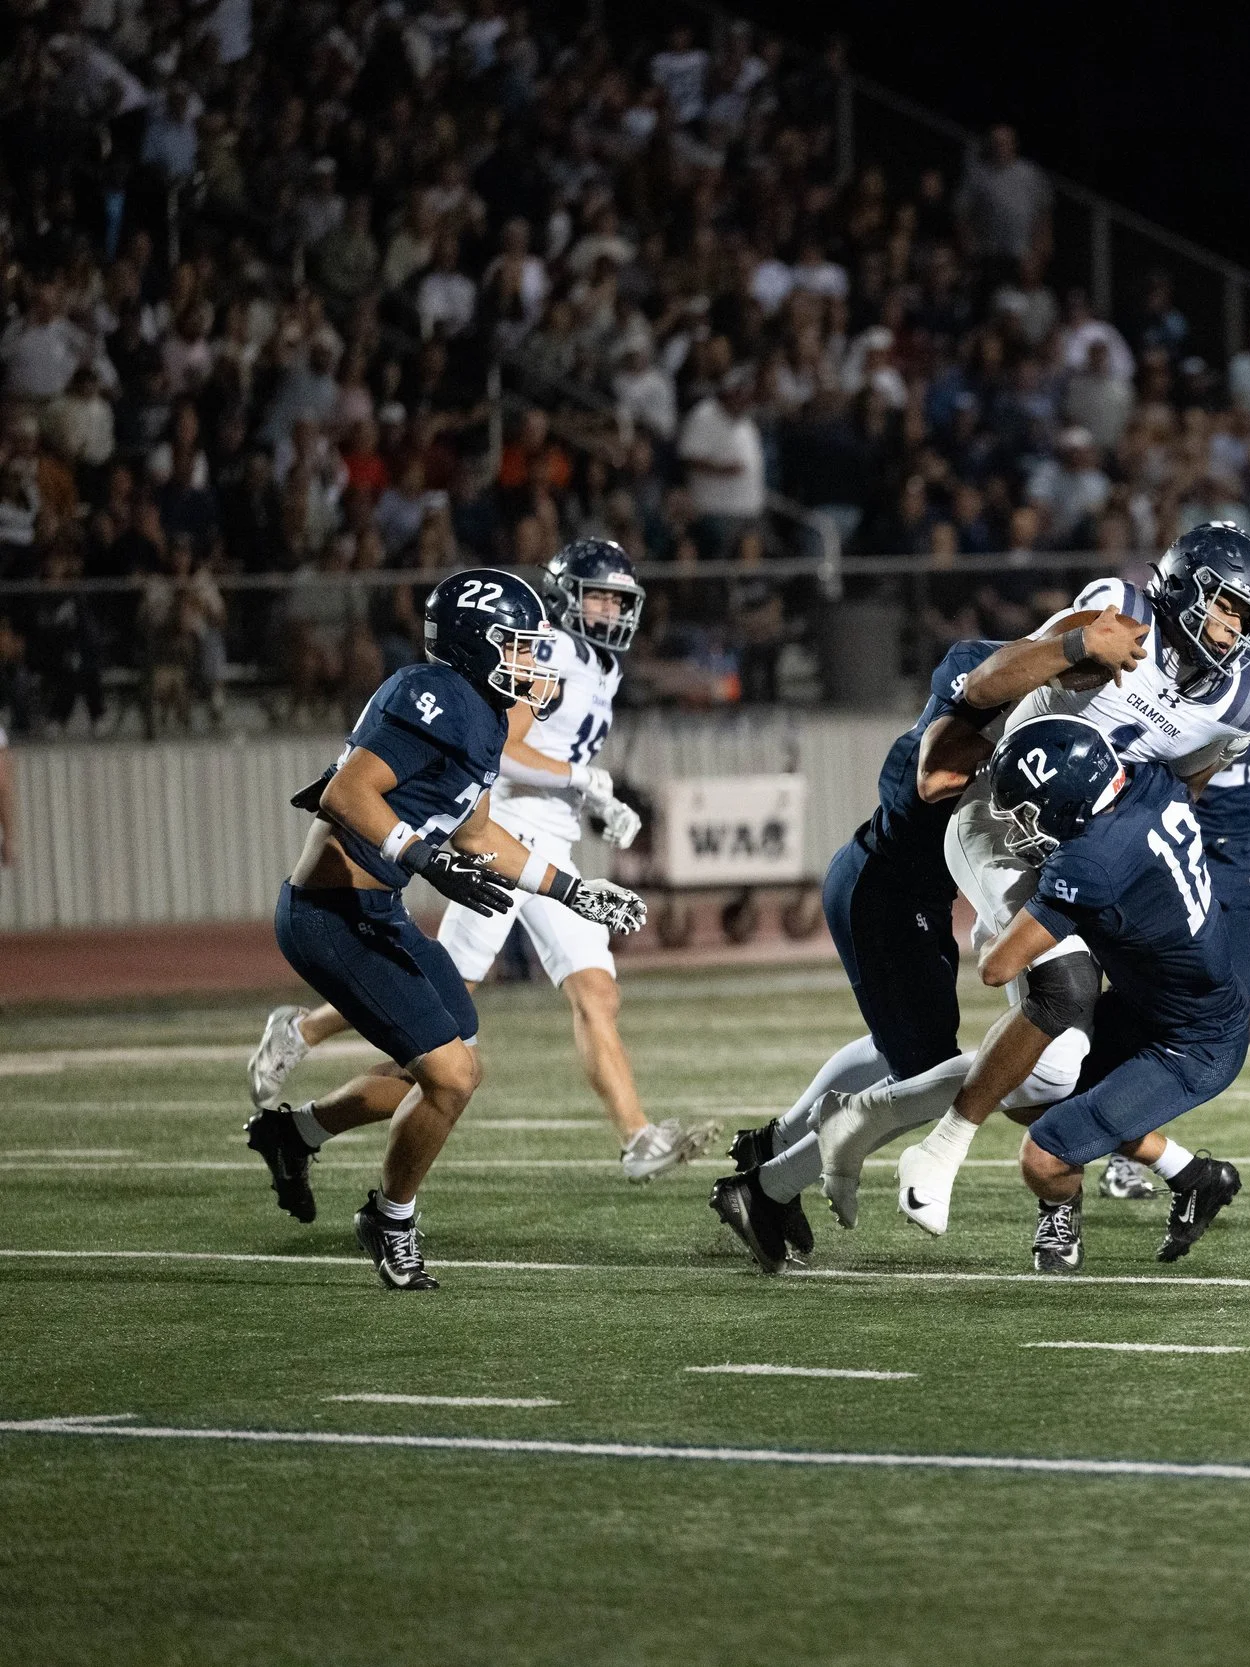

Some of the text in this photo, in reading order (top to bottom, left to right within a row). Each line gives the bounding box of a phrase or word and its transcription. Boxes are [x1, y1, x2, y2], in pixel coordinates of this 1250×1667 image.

[456, 579, 504, 614] 22
[1079, 584, 1112, 609] 1
[415, 691, 444, 725] SV
[1126, 692, 1182, 738] CHAMPION
[1017, 747, 1059, 789] 12
[415, 781, 490, 841] 2
[1147, 799, 1212, 937] 12
[1054, 878, 1079, 904] SV
